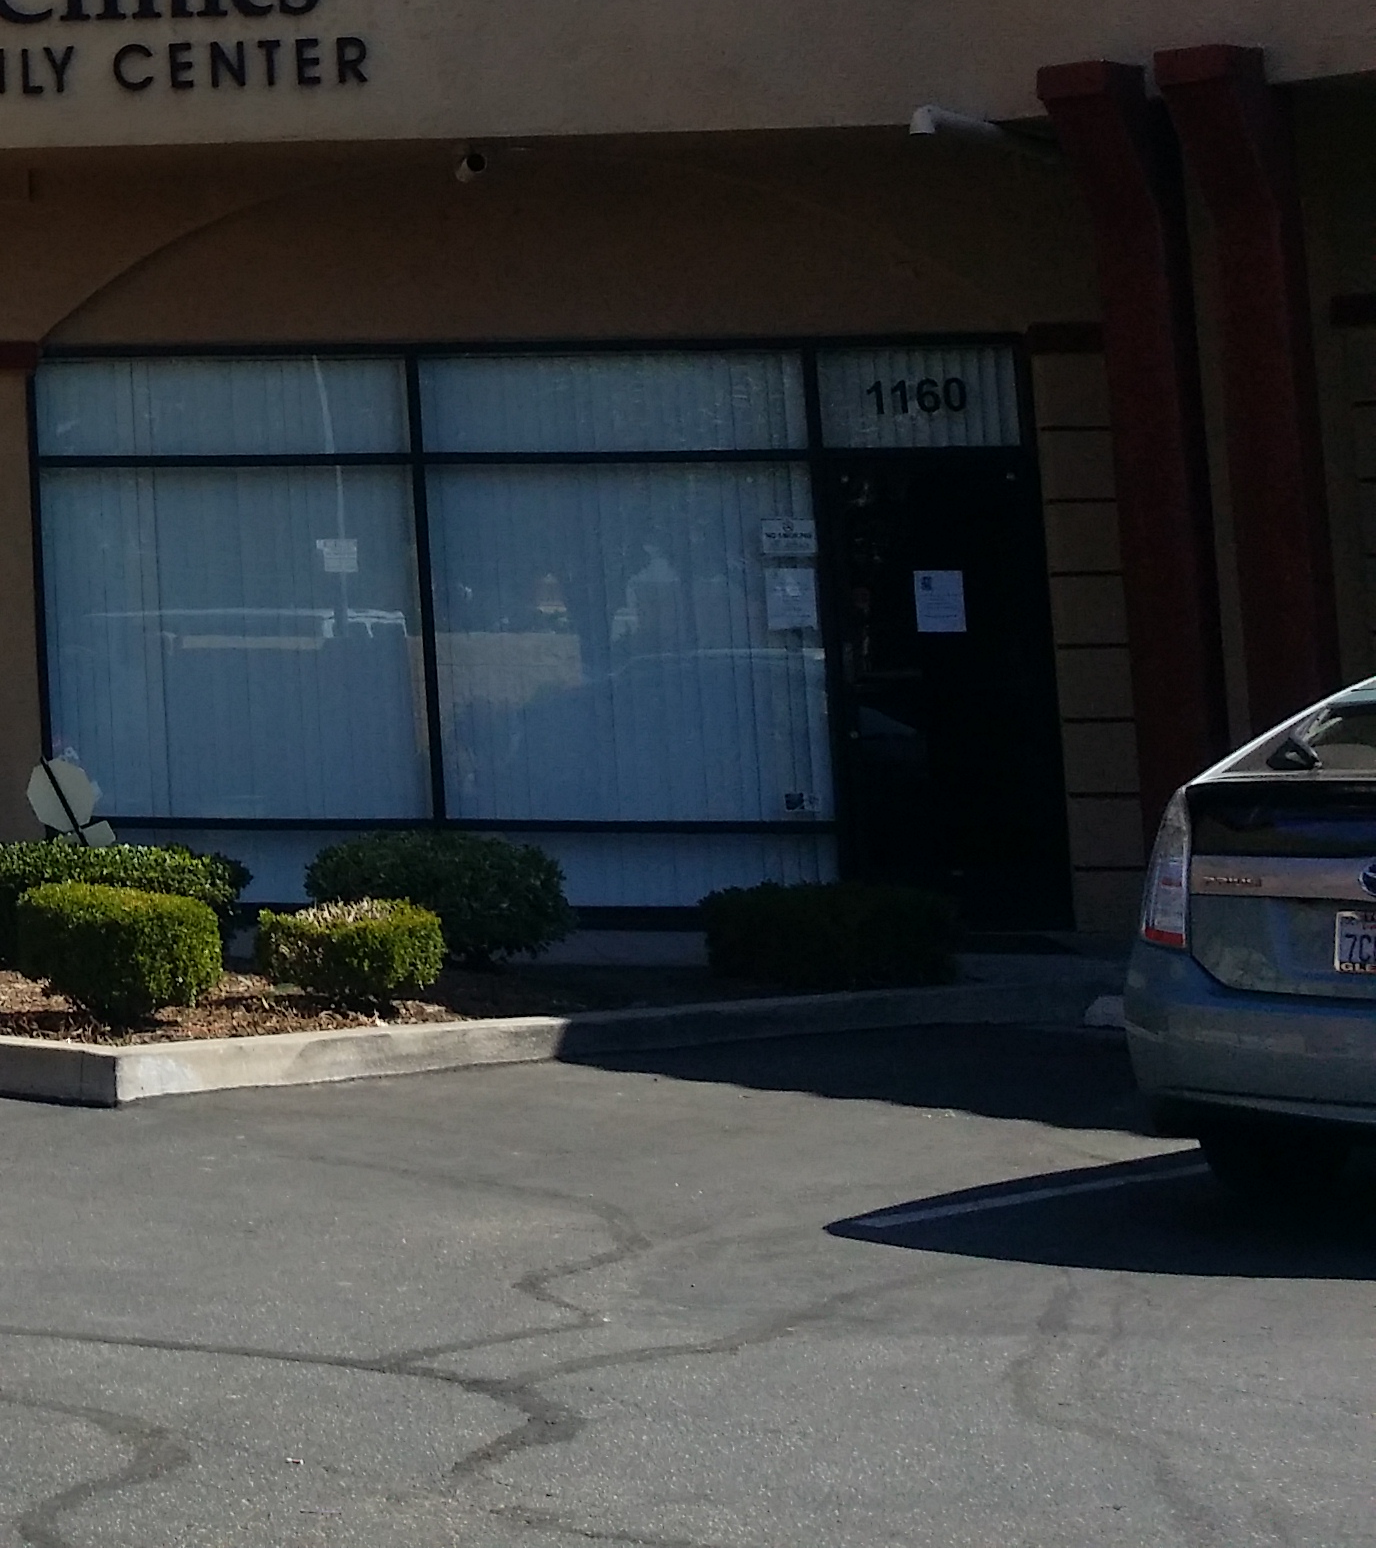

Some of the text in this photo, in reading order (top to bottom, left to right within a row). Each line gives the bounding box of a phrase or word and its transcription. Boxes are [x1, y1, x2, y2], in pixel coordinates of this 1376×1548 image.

[113, 36, 370, 93] CENTER
[866, 377, 967, 414] 1160
[1344, 933, 1376, 962] 7C
